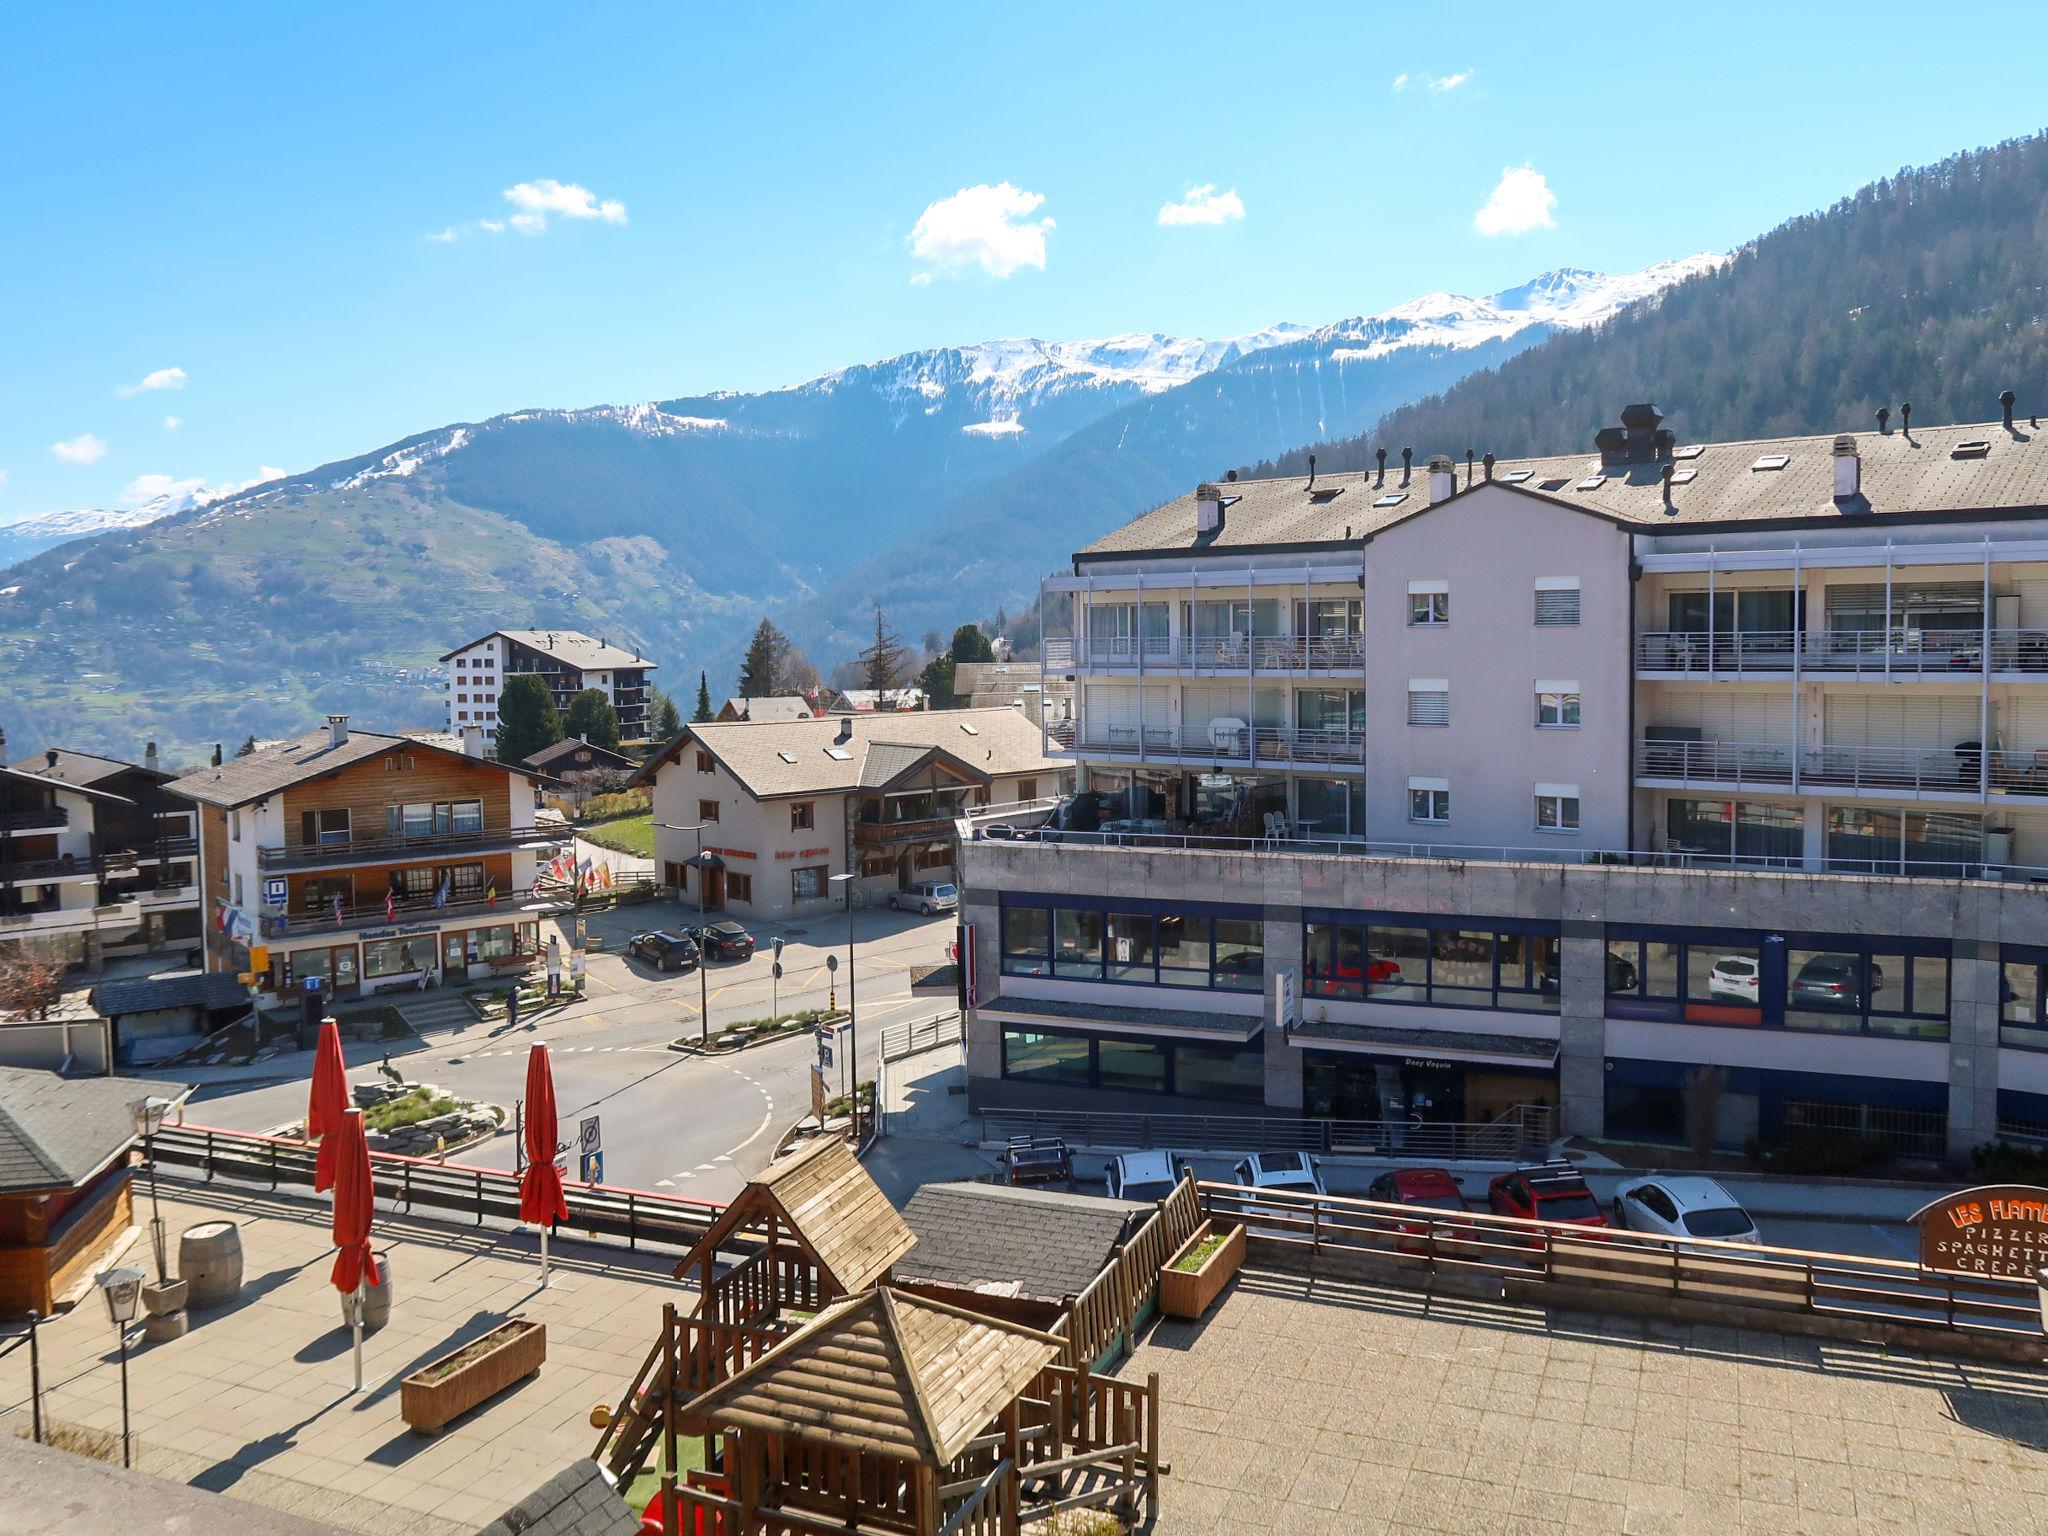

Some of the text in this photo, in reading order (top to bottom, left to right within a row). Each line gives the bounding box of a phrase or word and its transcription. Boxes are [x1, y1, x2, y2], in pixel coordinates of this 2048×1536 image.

[1947, 1202, 1983, 1229] LES
[1966, 1227, 2048, 1245] PIZZER
[1937, 1241, 2048, 1262] SPAGHETT
